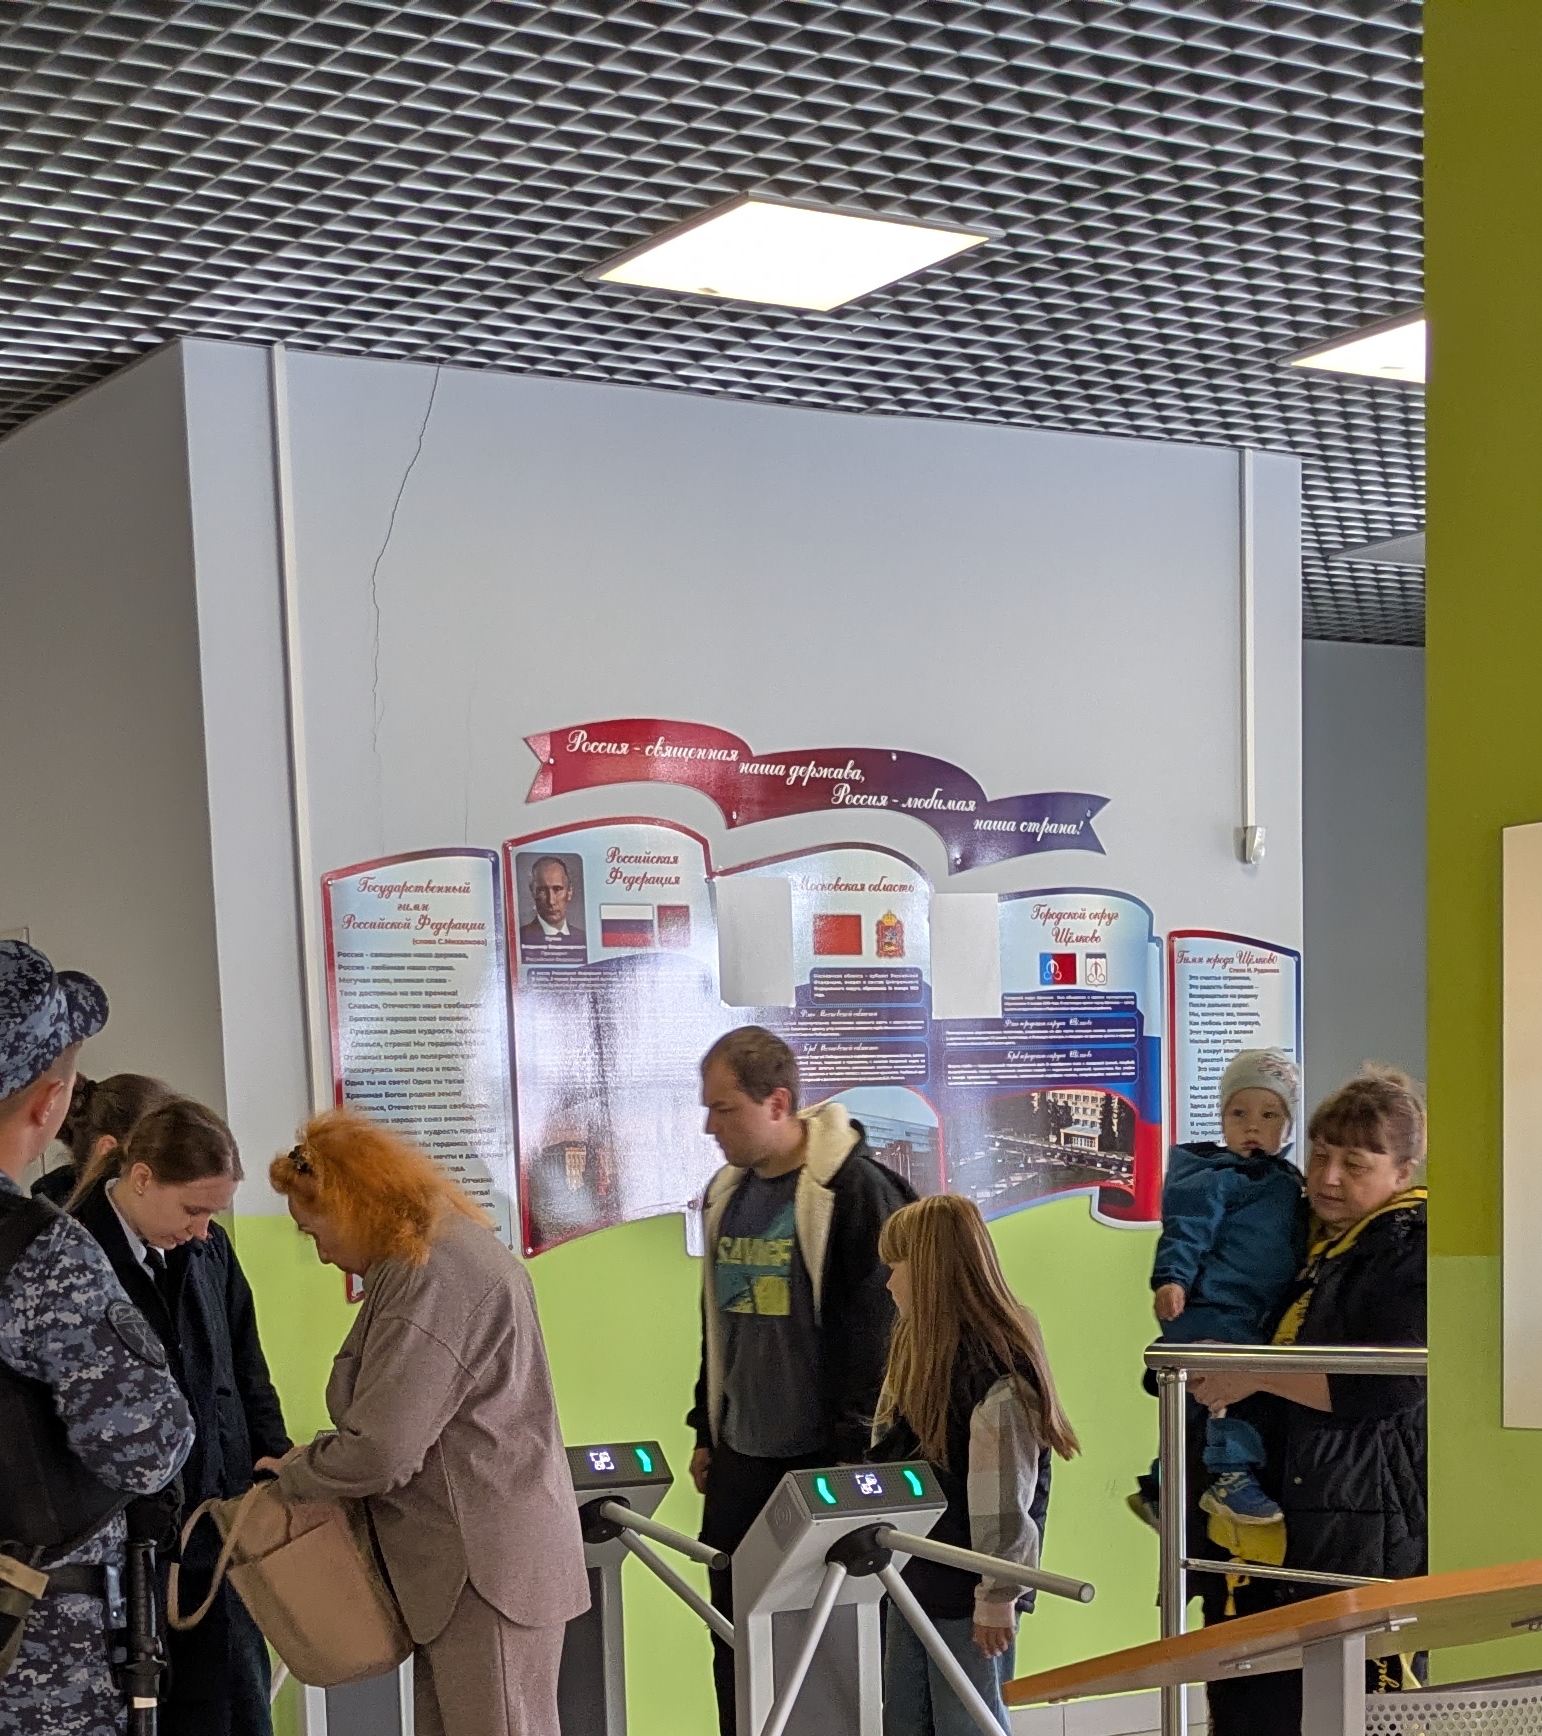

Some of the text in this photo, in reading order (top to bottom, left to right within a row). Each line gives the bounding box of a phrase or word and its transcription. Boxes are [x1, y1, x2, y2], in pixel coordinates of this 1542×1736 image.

[566, 729, 629, 754] Россия
[645, 736, 739, 762] священная
[739, 760, 865, 786] наша держава,
[831, 783, 888, 807] Россия
[902, 788, 976, 812] любимая
[973, 816, 1084, 842] наша страна!
[606, 846, 679, 865] Российская
[357, 876, 471, 898] Государственный
[606, 867, 680, 891] Федерация
[868, 876, 914, 892] область
[342, 914, 486, 936] Российской Федерации
[1030, 904, 1119, 926] Городской округ
[1051, 927, 1102, 946] Щёлково
[1206, 954, 1234, 969] города
[1235, 950, 1277, 966] Щёлково
